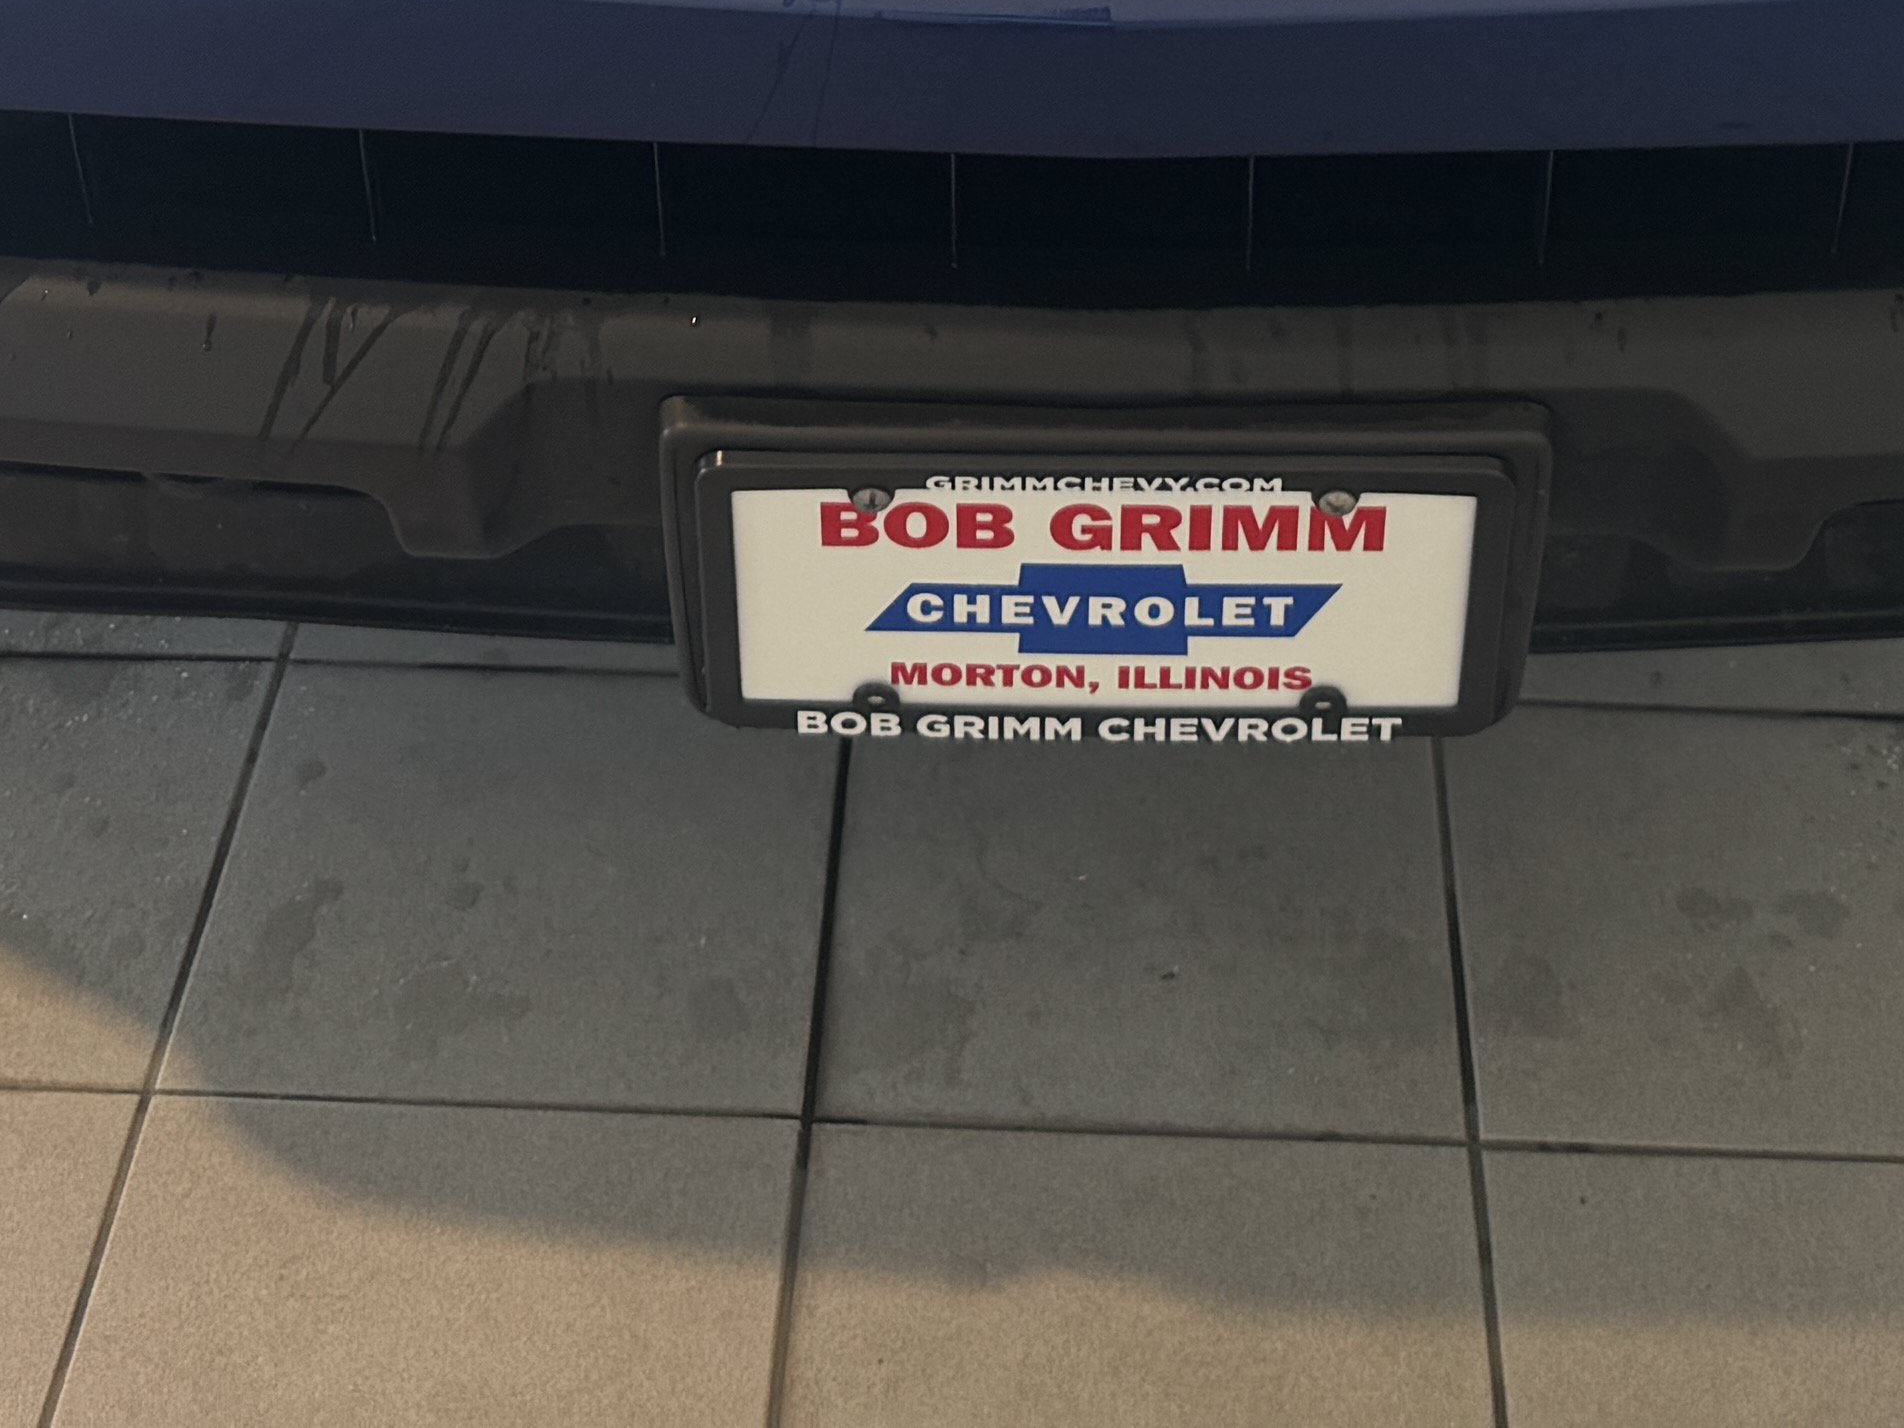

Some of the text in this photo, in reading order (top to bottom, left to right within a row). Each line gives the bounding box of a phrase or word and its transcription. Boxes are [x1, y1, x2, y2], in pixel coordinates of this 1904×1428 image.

[925, 475, 1284, 493] GRIMMCHEVY.COM
[820, 501, 1387, 552] BOB GRIMM
[906, 592, 1294, 627] CHEVROLET
[890, 661, 1313, 694] MORTON, ILLINOIS
[796, 710, 1403, 743] BOB GRIMM CHEVROLET
